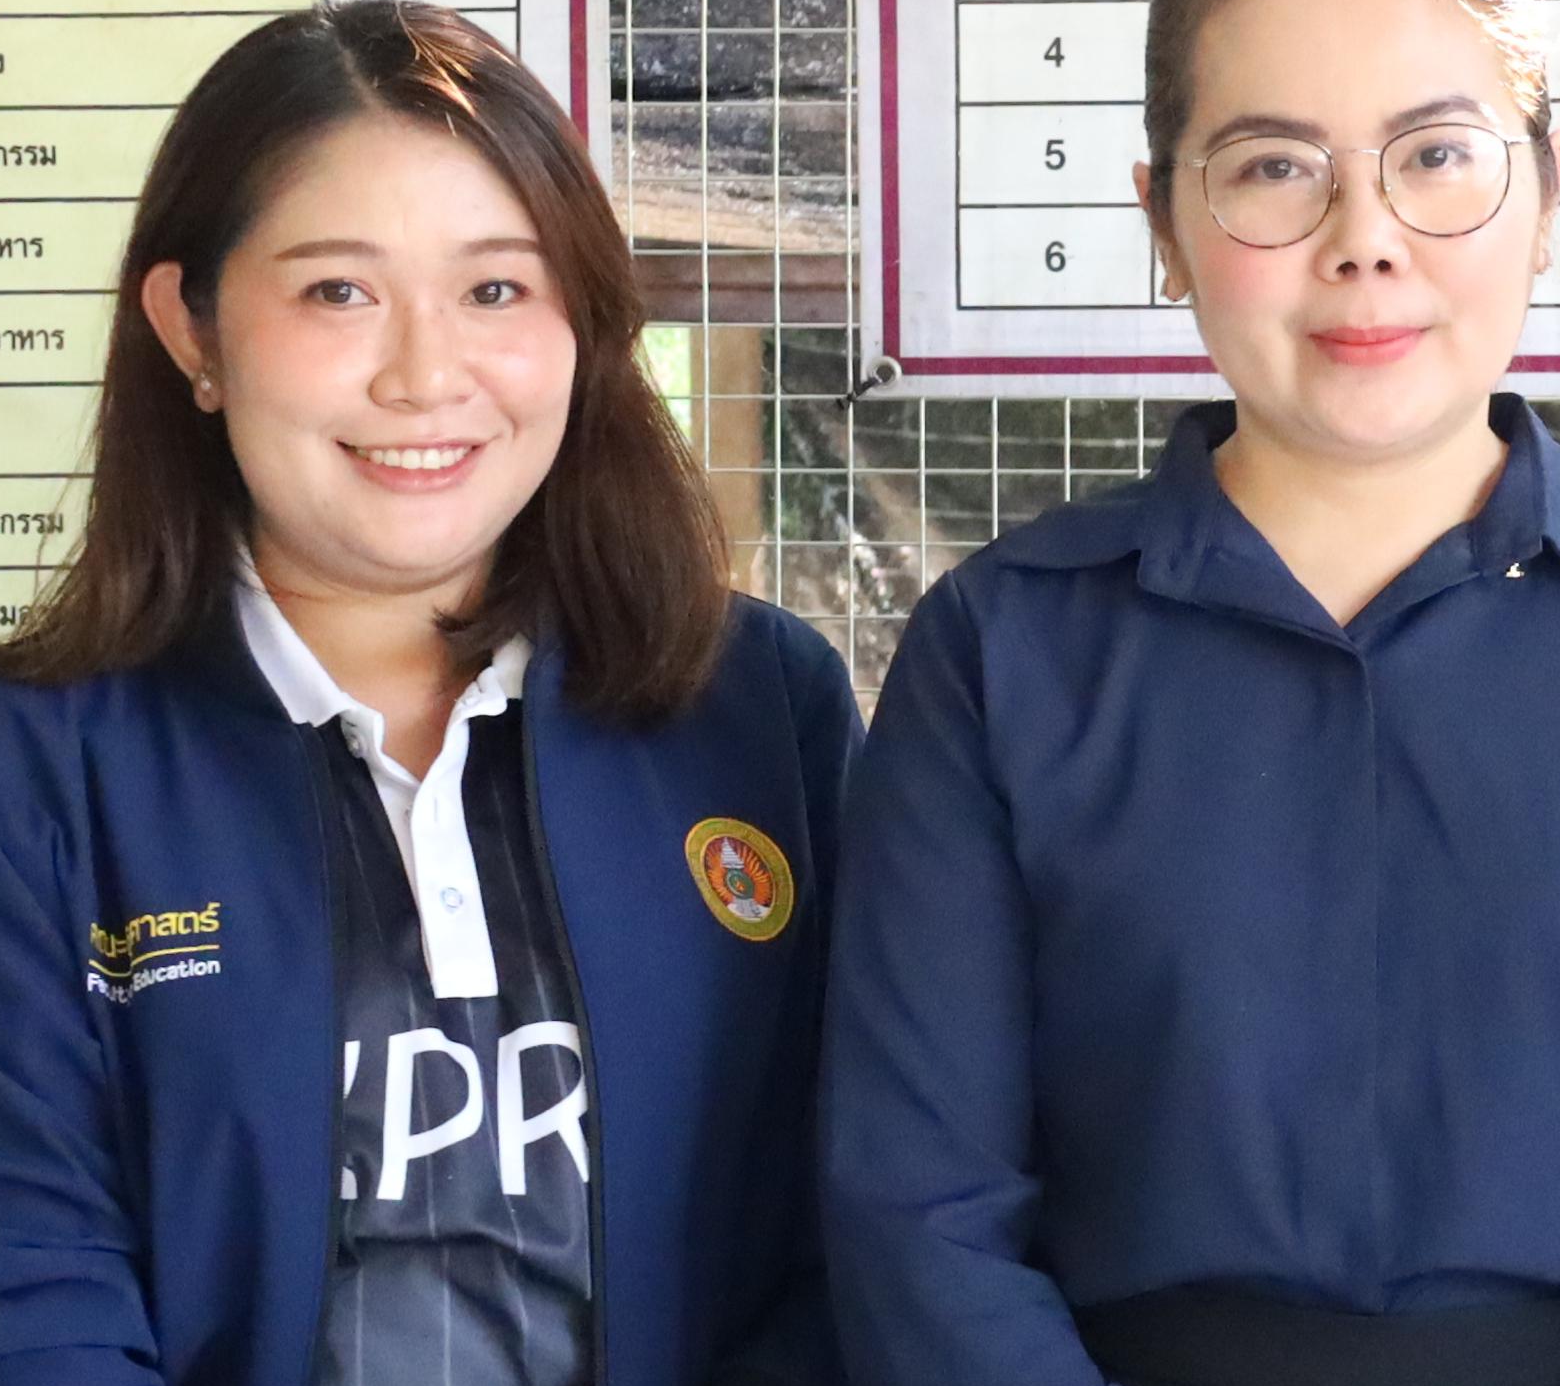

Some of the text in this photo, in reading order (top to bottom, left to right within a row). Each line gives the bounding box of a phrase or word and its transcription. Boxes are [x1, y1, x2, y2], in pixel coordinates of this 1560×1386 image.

[1043, 36, 1065, 68] 4
[1044, 139, 1066, 171] 5
[1044, 240, 1067, 273] 6
[132, 959, 221, 992] Education
